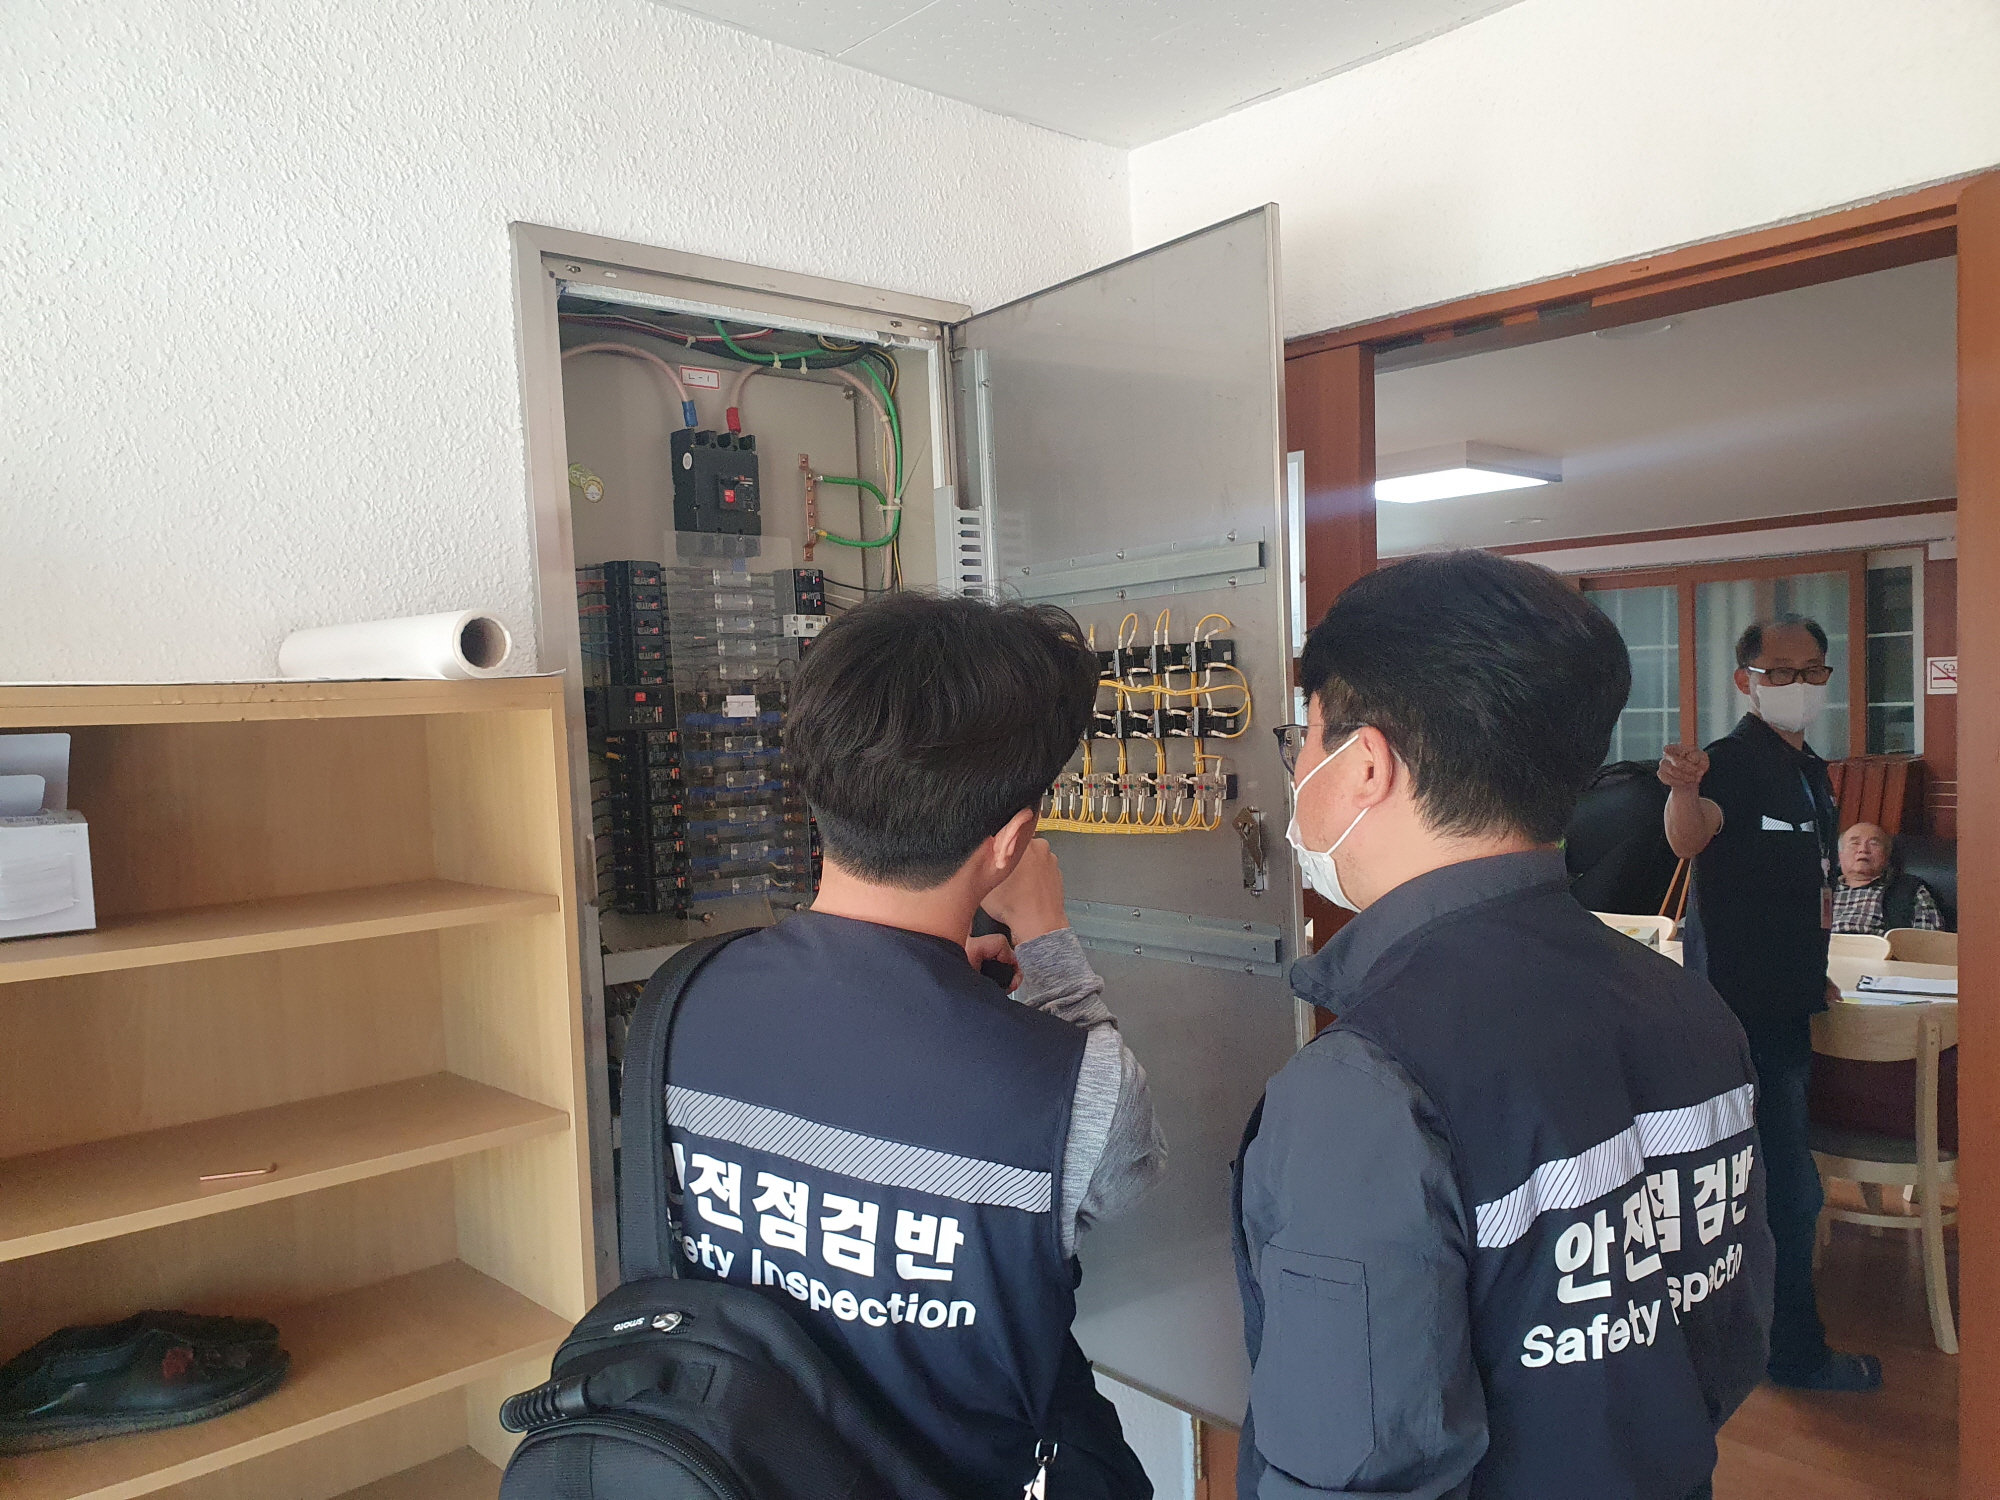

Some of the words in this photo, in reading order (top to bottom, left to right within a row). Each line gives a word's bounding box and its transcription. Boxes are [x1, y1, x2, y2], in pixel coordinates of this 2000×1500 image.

[671, 1142, 965, 1282] 전점검반
[751, 1248, 977, 1330] Inspection
[1520, 1299, 1662, 1368] Safety
